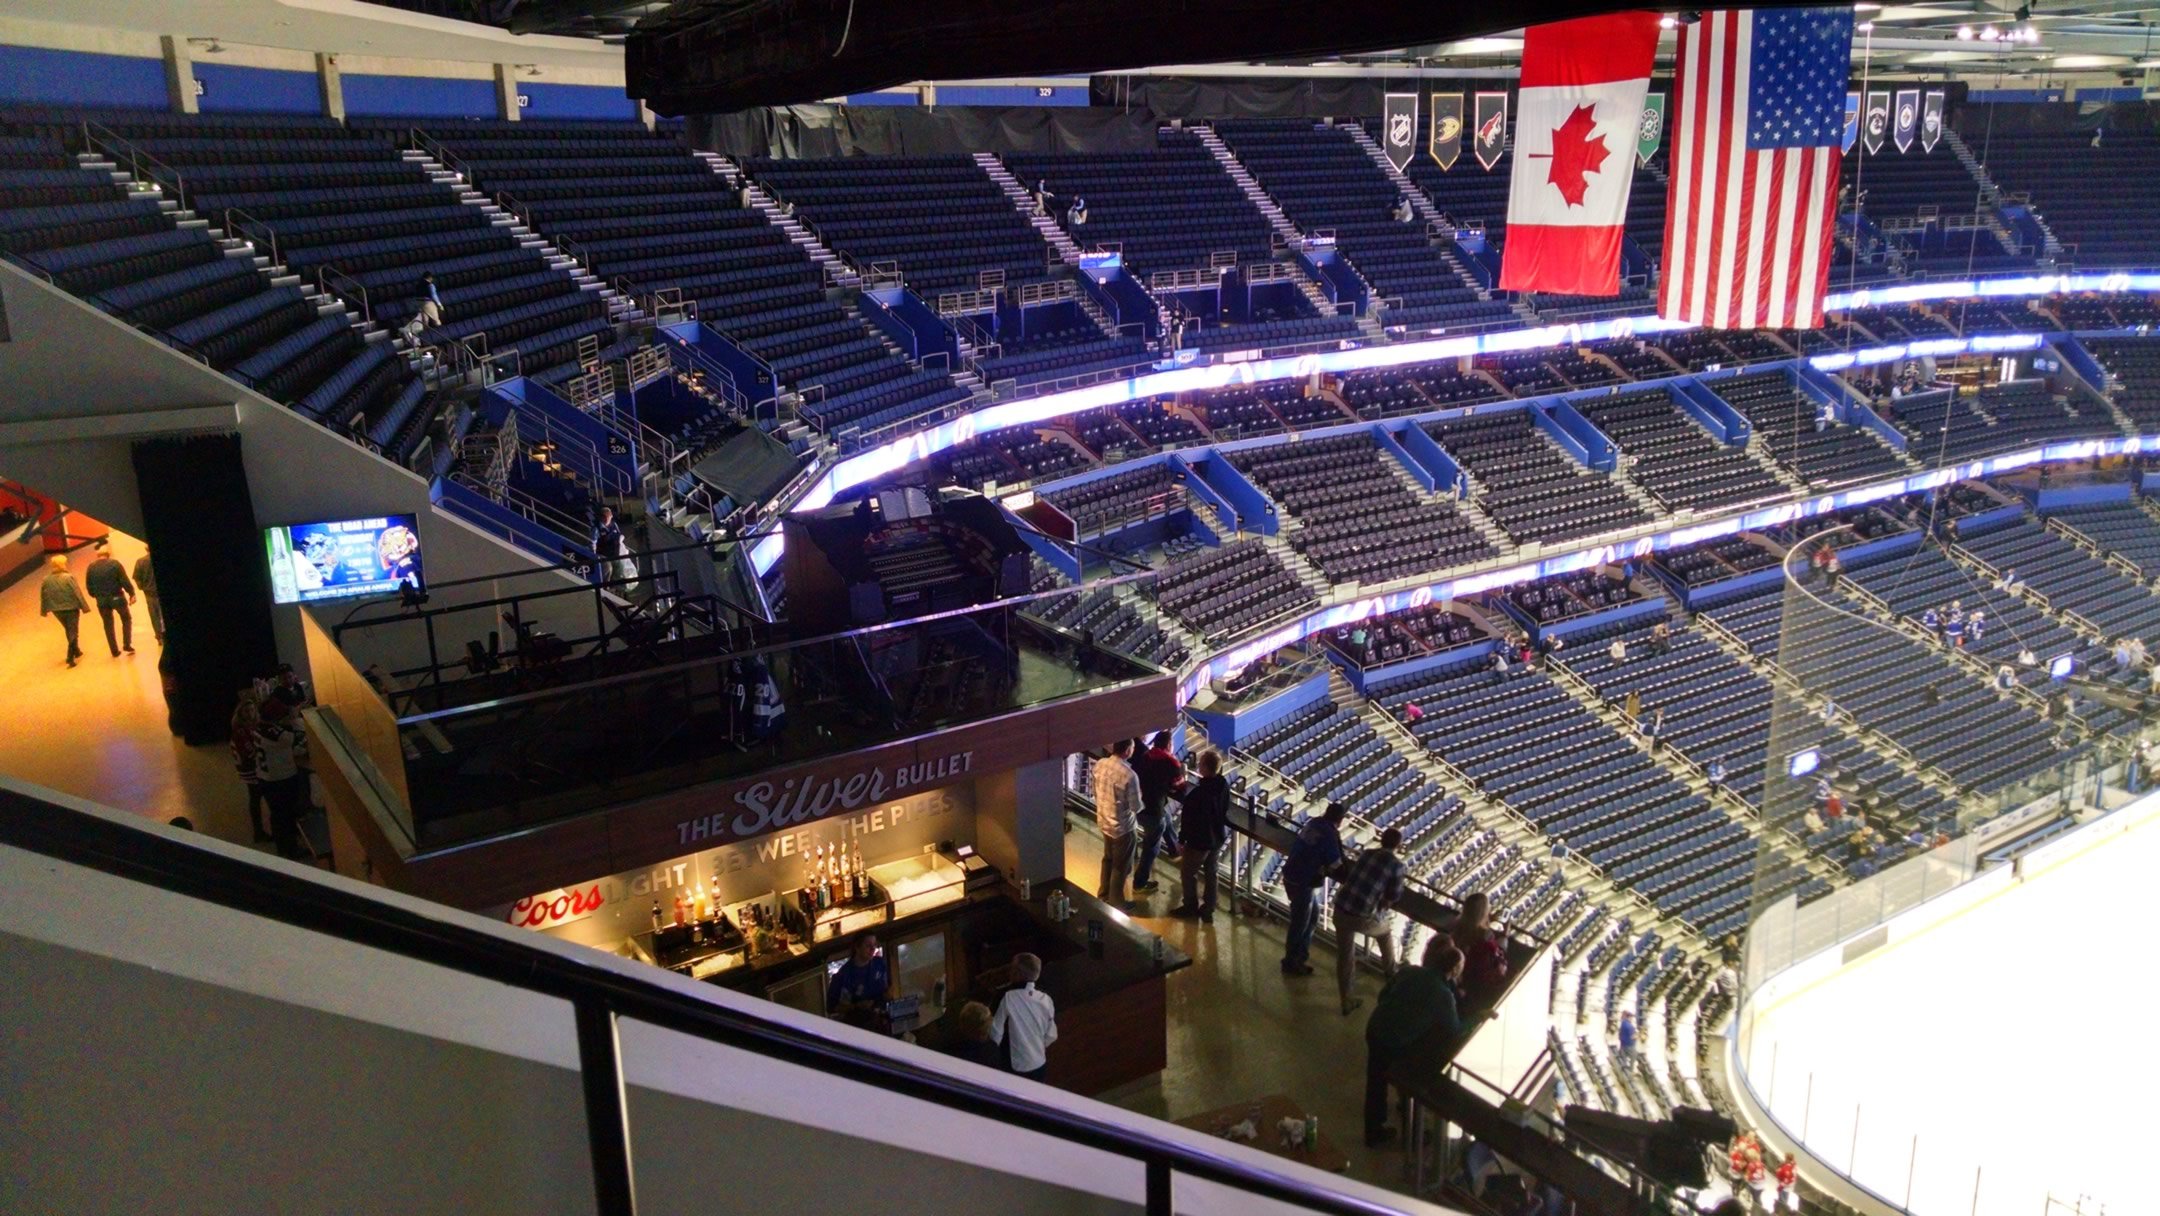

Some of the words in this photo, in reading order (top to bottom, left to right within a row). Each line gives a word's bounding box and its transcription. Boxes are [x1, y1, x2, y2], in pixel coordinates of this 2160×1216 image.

[1039, 87, 1052, 97] 329
[610, 445, 627, 454] 326
[304, 586, 338, 598] WELCOME
[677, 812, 725, 845] THE
[731, 767, 891, 836] Silver
[895, 751, 974, 790] BULLET
[840, 809, 885, 840] THE
[507, 883, 605, 927] Coors
[605, 862, 688, 905] LIGHT
